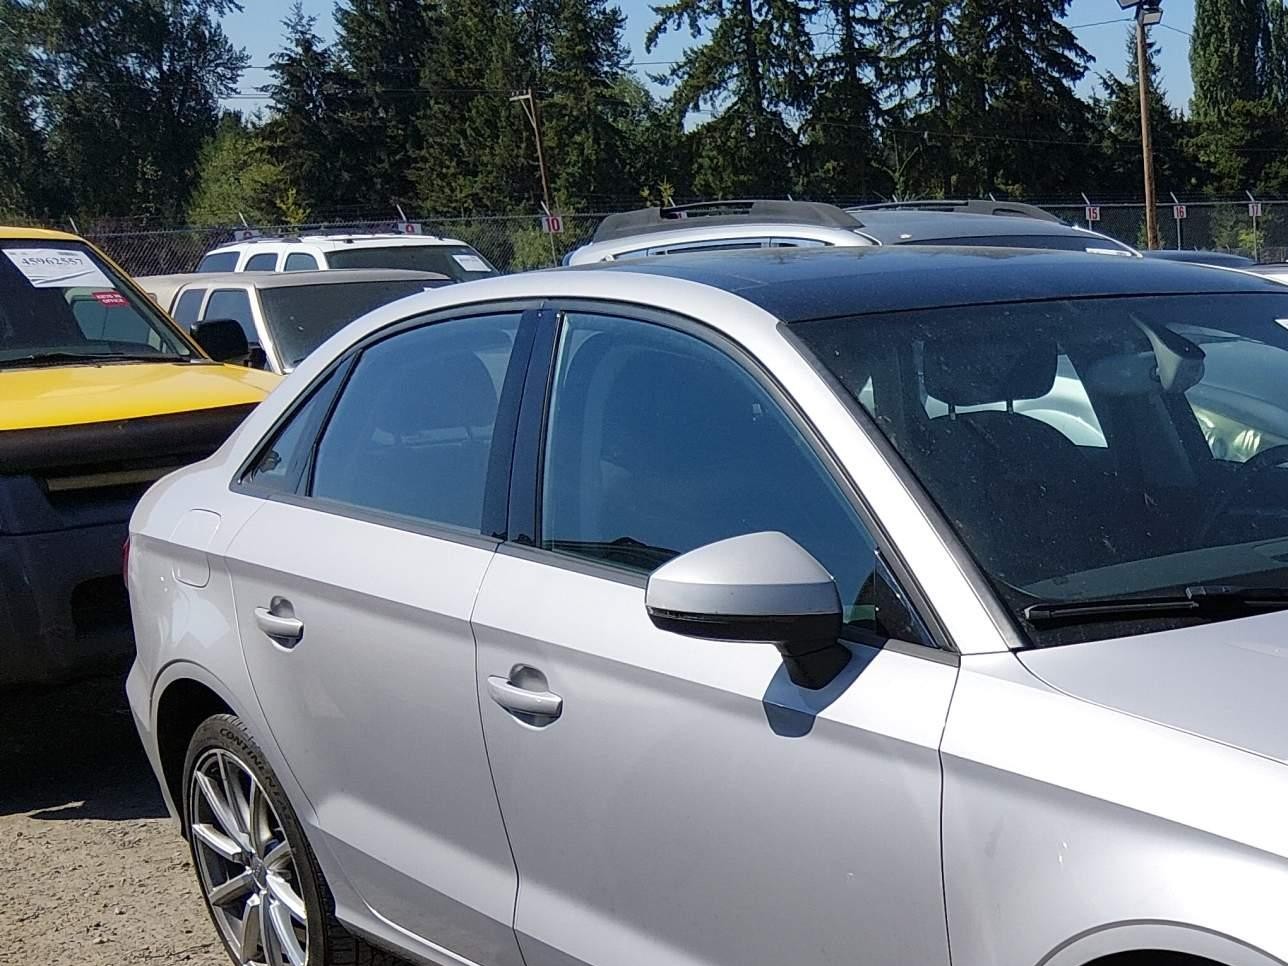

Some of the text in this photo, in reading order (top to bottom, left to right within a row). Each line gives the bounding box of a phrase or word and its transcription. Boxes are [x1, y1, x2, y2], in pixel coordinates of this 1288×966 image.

[1087, 207, 1098, 219] 15
[1175, 205, 1185, 218] 16
[545, 217, 560, 232] 10
[22, 257, 84, 266] 45962557
